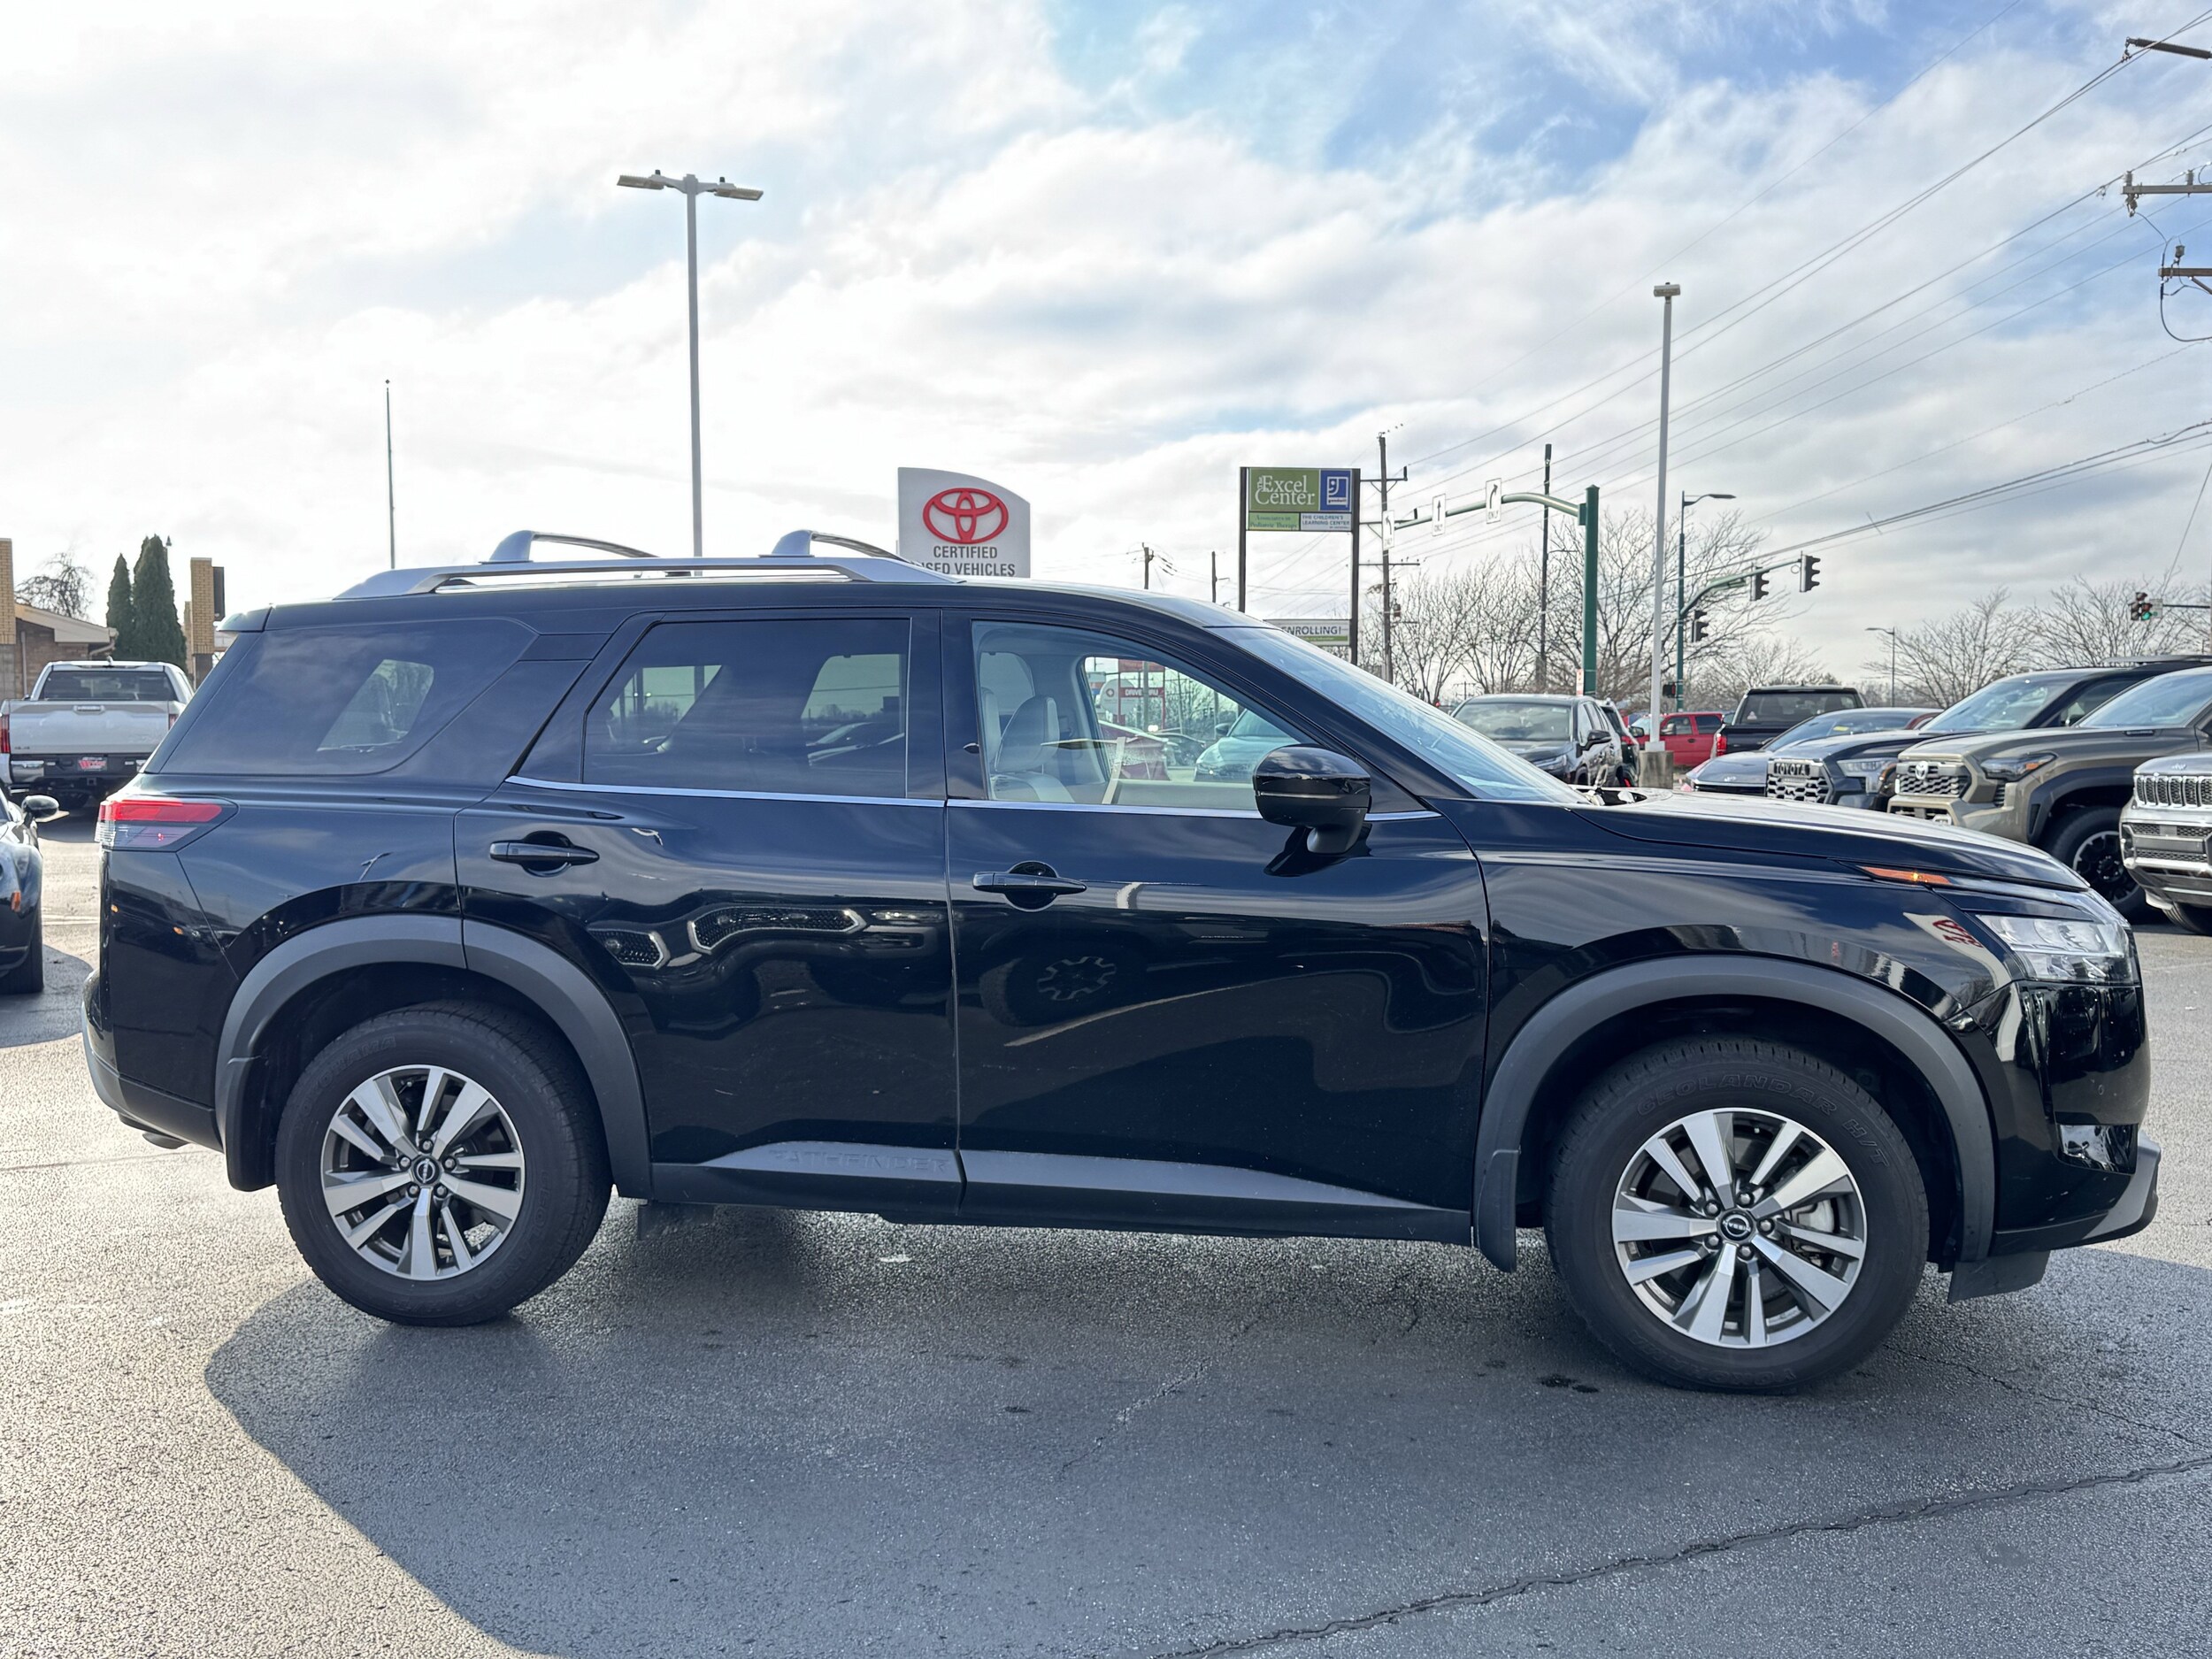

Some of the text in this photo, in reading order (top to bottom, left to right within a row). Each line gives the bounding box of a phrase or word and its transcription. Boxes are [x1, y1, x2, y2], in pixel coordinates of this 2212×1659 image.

[1262, 475, 1308, 493] Excel
[1255, 488, 1316, 505] Center
[933, 545, 997, 559] CERTIFIED
[955, 564, 1016, 577] VEHICLES
[1775, 763, 1807, 776] TOYOTA
[1637, 1073, 1890, 1168] GEOLANDAR H/T
[772, 1151, 951, 1174] PATHFINDER
